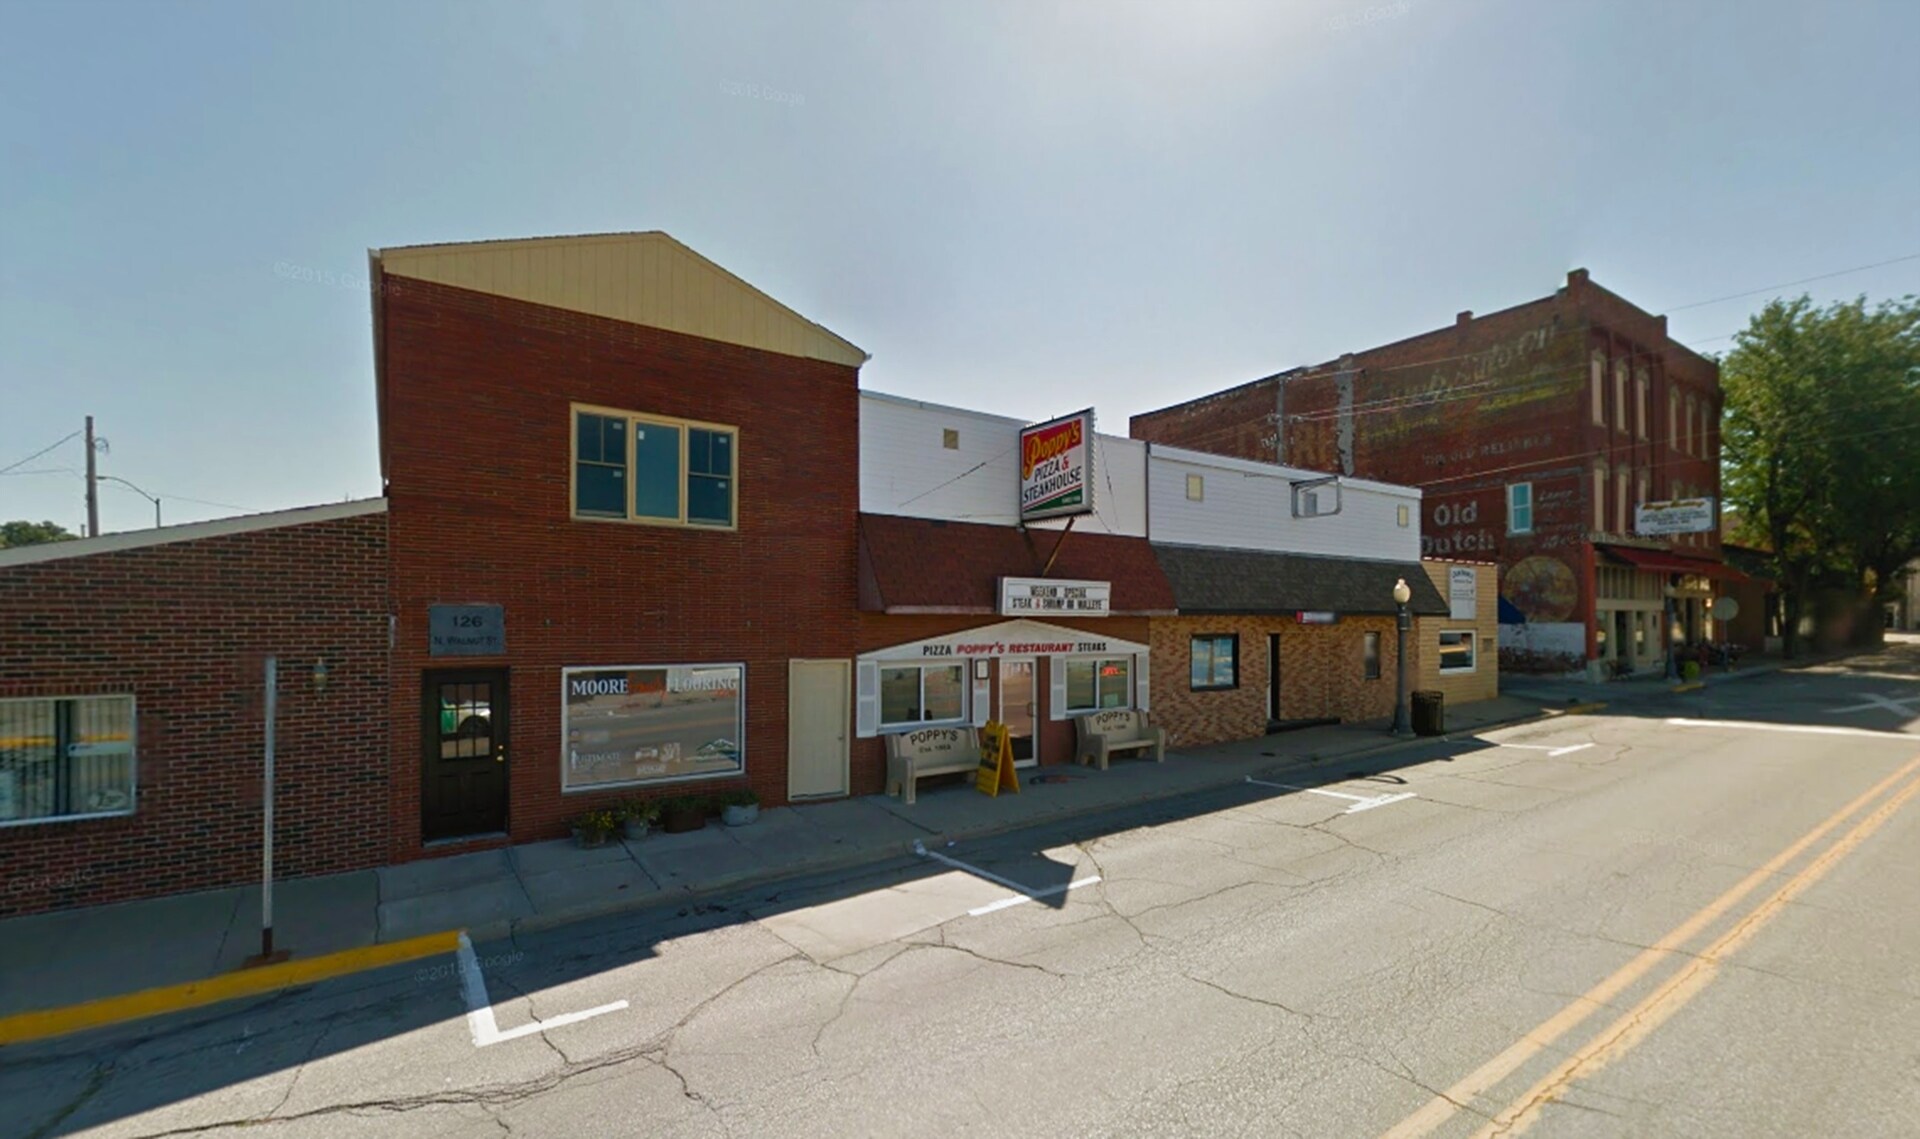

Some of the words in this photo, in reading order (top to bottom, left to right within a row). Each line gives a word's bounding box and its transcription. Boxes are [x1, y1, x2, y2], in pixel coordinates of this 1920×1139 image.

[1023, 420, 1081, 481] Poppy's
[1034, 459, 1060, 483] PIZZA
[1061, 455, 1070, 471] &
[1023, 466, 1082, 504] STEAKHOUSE
[1433, 499, 1478, 527] Old
[1012, 598, 1032, 609] STEAK
[453, 615, 483, 628] 126
[922, 644, 951, 656] PIZZA
[956, 641, 1005, 655] POPPY'S
[1008, 642, 1075, 653] RESTAURANT
[1077, 642, 1107, 652] STEAKS
[571, 678, 629, 697] MOORE
[666, 675, 737, 693] FLOORING
[1096, 710, 1131, 725] POPPY'S
[909, 729, 959, 746] POPPY'S
